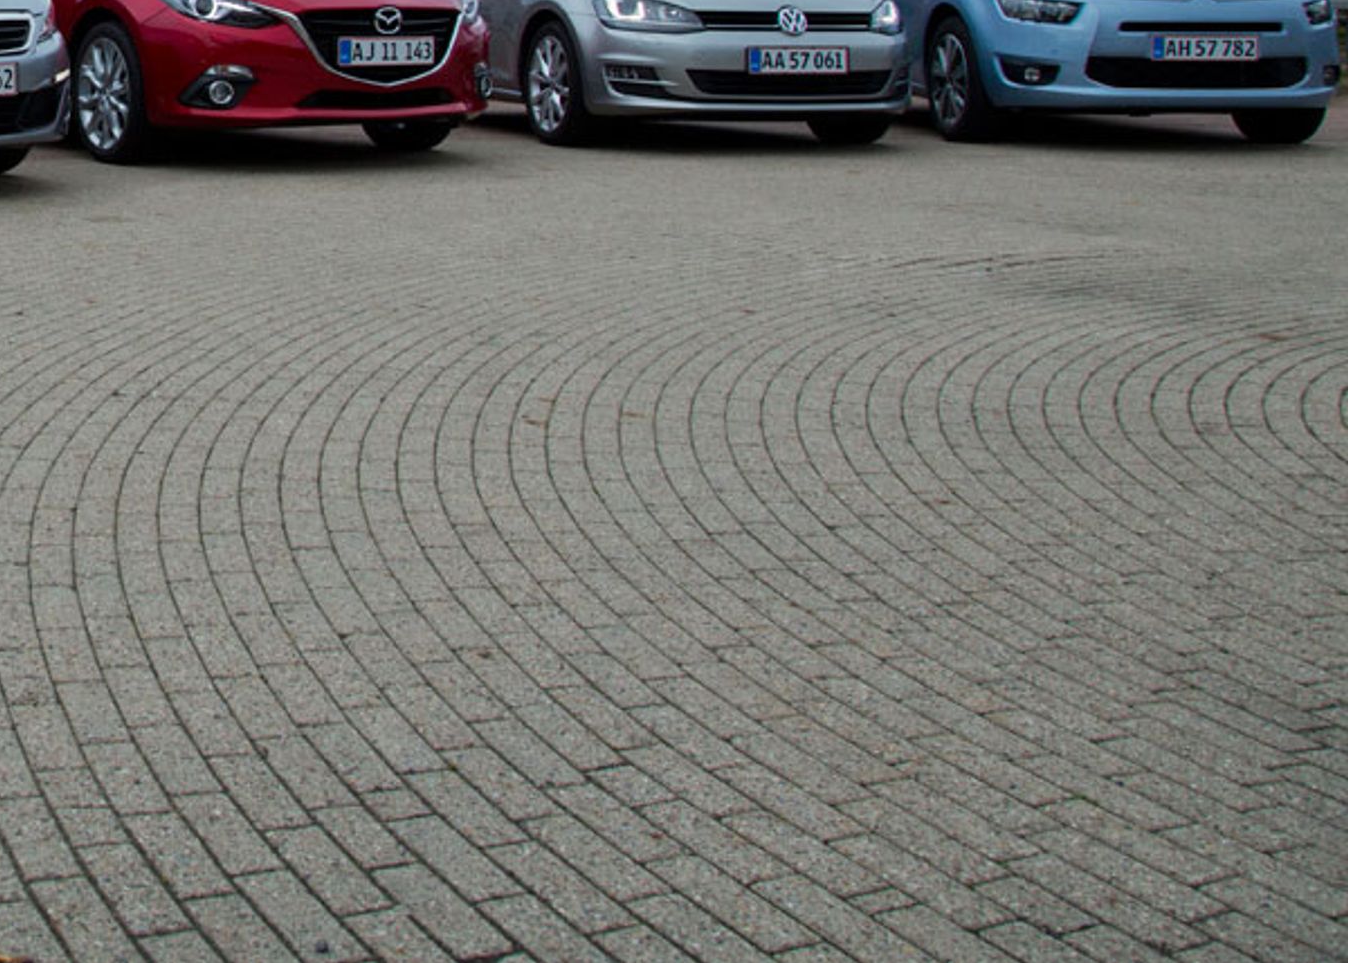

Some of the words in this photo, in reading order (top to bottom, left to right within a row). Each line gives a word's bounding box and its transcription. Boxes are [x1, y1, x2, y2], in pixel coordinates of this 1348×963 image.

[352, 42, 375, 61] AJ
[382, 42, 398, 61] 11
[405, 41, 432, 60] 143
[1165, 39, 1192, 57] AH
[1194, 39, 1219, 57] 57
[1221, 39, 1255, 57] 782
[762, 51, 786, 69] AA
[789, 51, 811, 69] 57
[813, 51, 844, 69] 061
